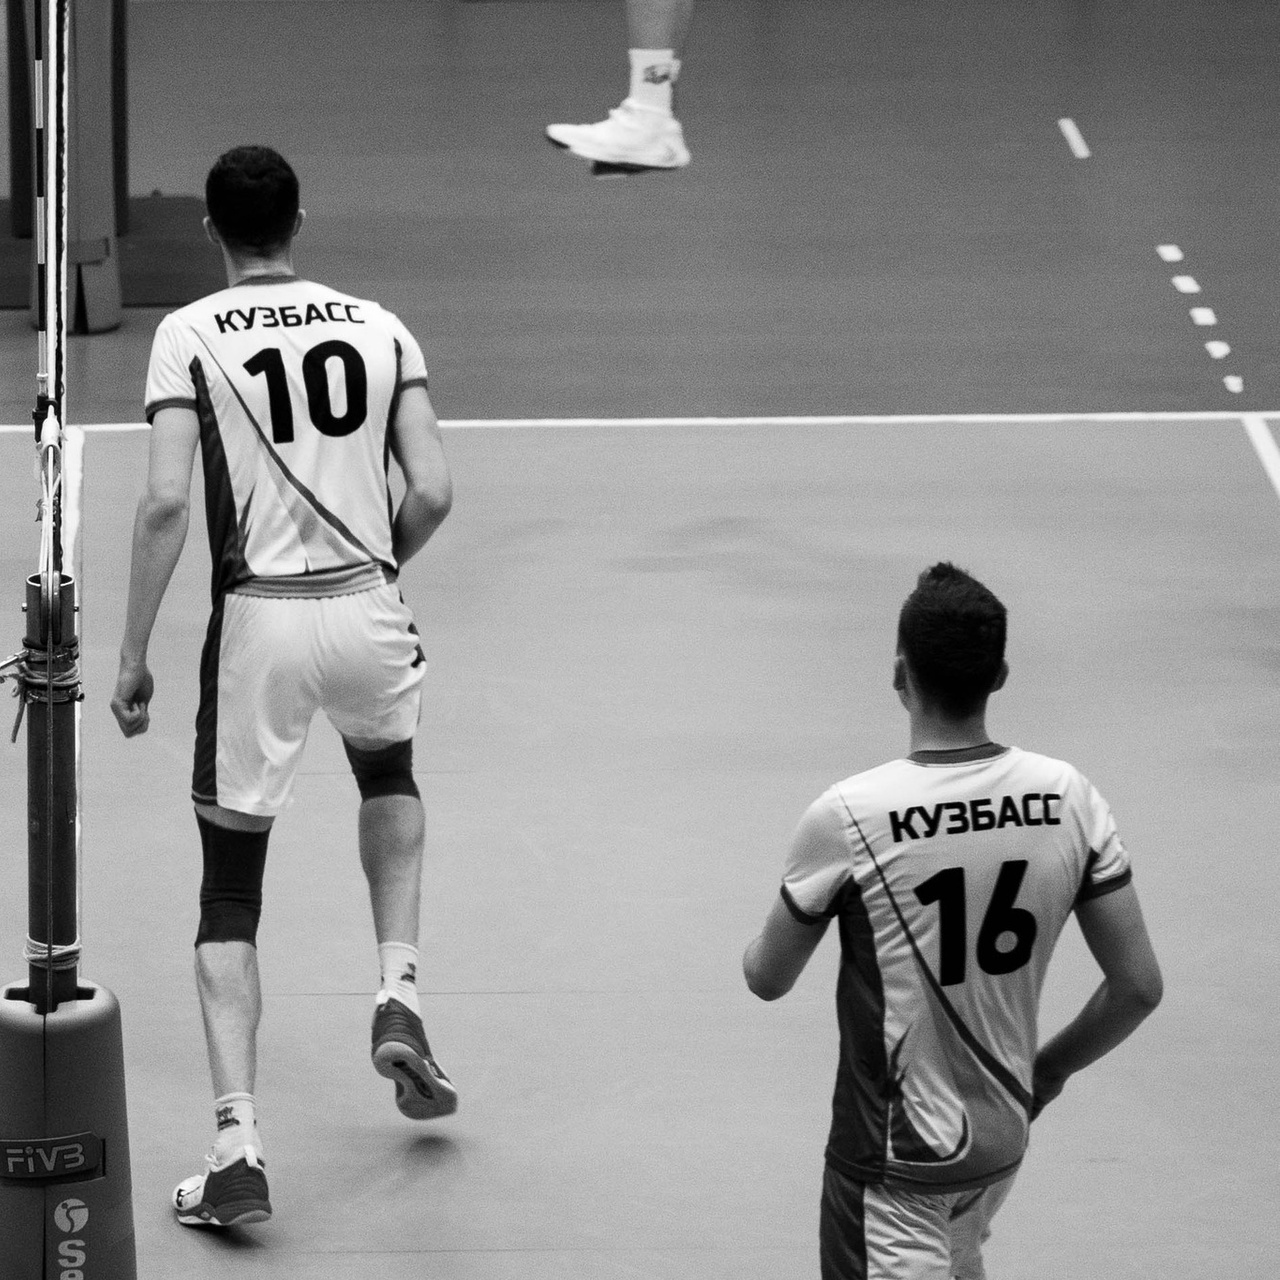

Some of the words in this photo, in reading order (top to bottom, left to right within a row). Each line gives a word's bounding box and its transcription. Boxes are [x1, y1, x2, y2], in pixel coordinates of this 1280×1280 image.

[214, 302, 365, 334] КУЗБАСС
[242, 339, 368, 445] 10
[888, 792, 1061, 843] КУЗБАСС
[913, 859, 1038, 987] 16
